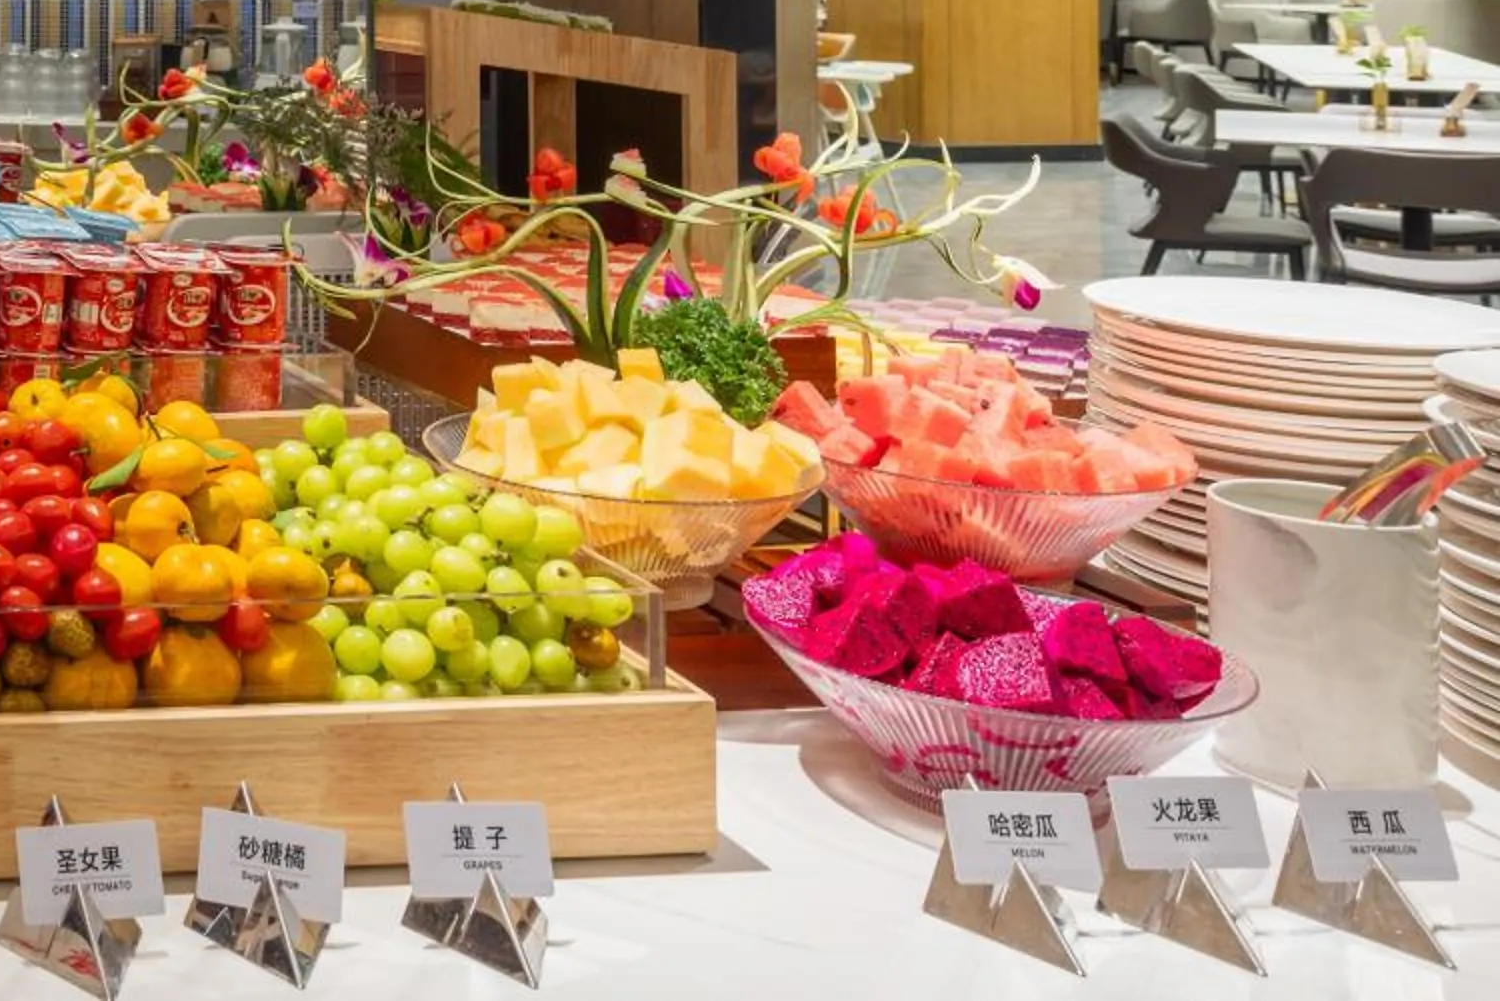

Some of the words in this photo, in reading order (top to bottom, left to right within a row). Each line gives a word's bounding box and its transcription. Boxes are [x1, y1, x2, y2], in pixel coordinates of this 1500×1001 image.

[1152, 797, 1220, 822] 火龙果
[988, 812, 1058, 839] 哈密瓜
[1347, 810, 1406, 835] 西瓜
[452, 823, 508, 850] 提子
[57, 846, 122, 874] 圣女果
[239, 835, 306, 871] 砂糖橘
[463, 860, 503, 871] GRAPES
[1011, 848, 1044, 858] MELON
[93, 880, 132, 892] TOMATO
